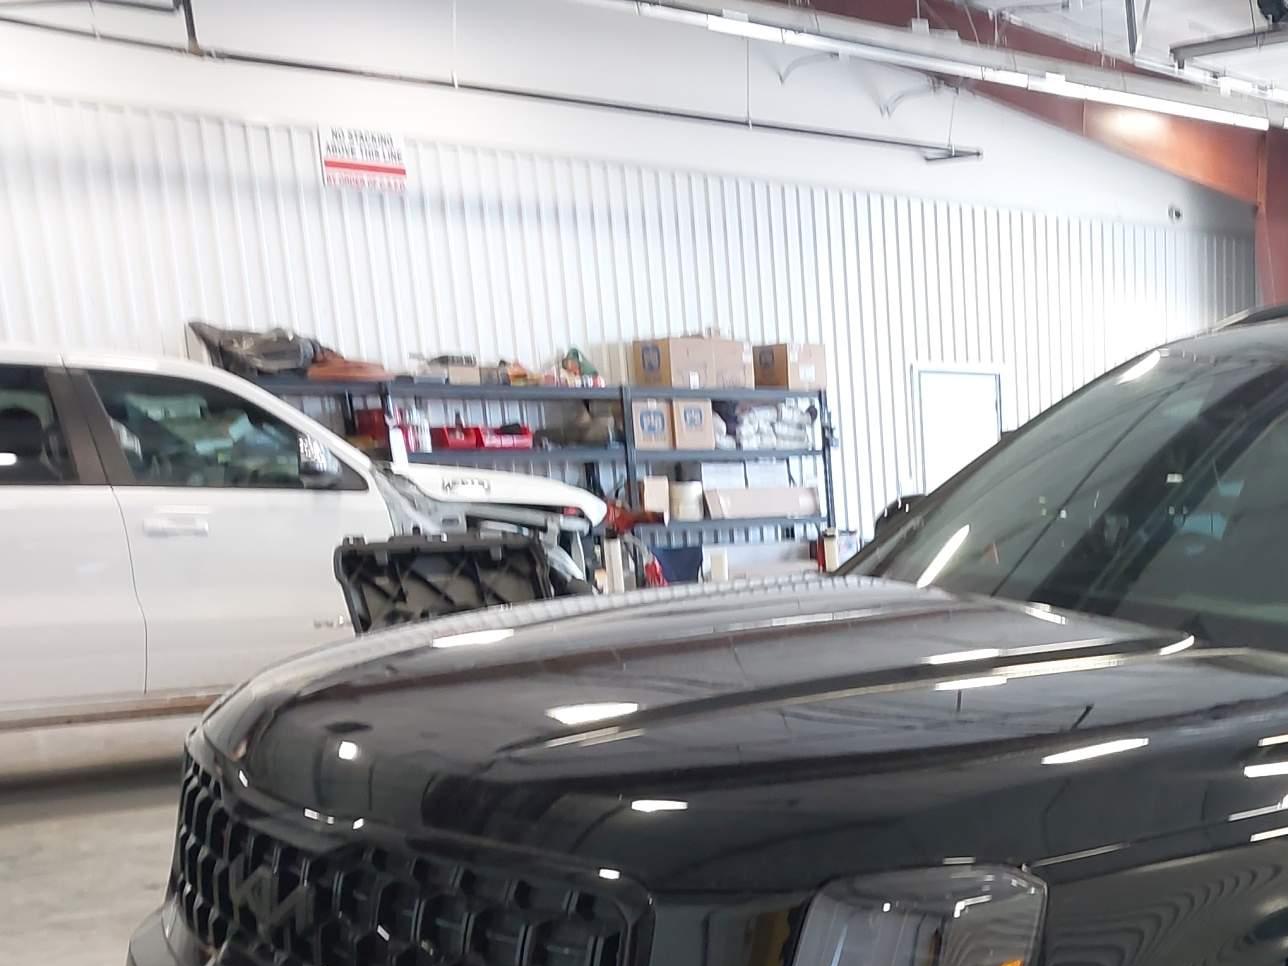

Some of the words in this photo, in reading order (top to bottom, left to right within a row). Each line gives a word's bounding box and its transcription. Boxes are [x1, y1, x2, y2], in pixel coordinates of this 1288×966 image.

[331, 128, 345, 141] NO
[348, 129, 394, 146] STACKING
[326, 142, 355, 156] ABOVE
[360, 145, 380, 160] THIS
[381, 147, 403, 162] LINE
